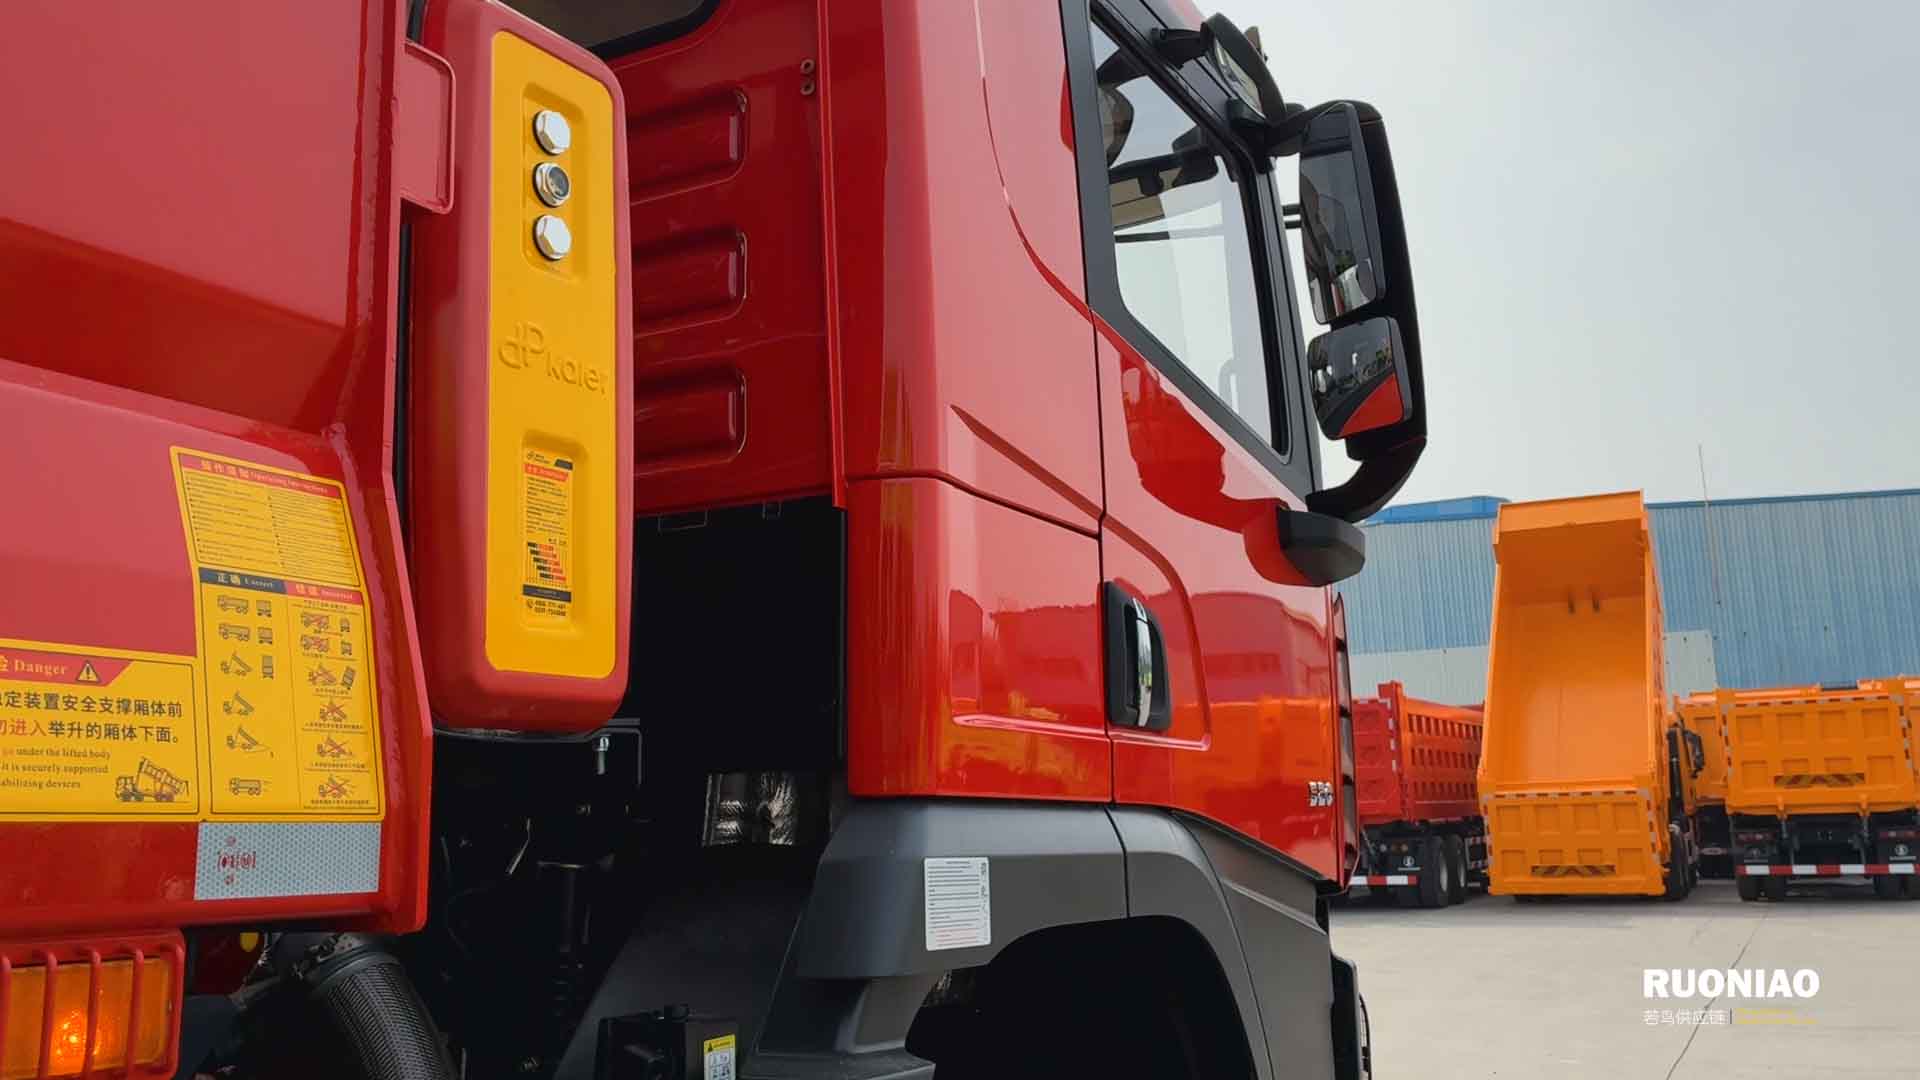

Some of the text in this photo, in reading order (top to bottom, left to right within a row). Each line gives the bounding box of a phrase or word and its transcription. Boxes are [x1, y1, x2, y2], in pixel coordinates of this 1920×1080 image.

[15, 659, 66, 677] Danger
[0, 691, 182, 717] 定装置安全支撑厢体前
[16, 747, 43, 757] under
[46, 747, 60, 758] the
[22, 763, 61, 776] securely
